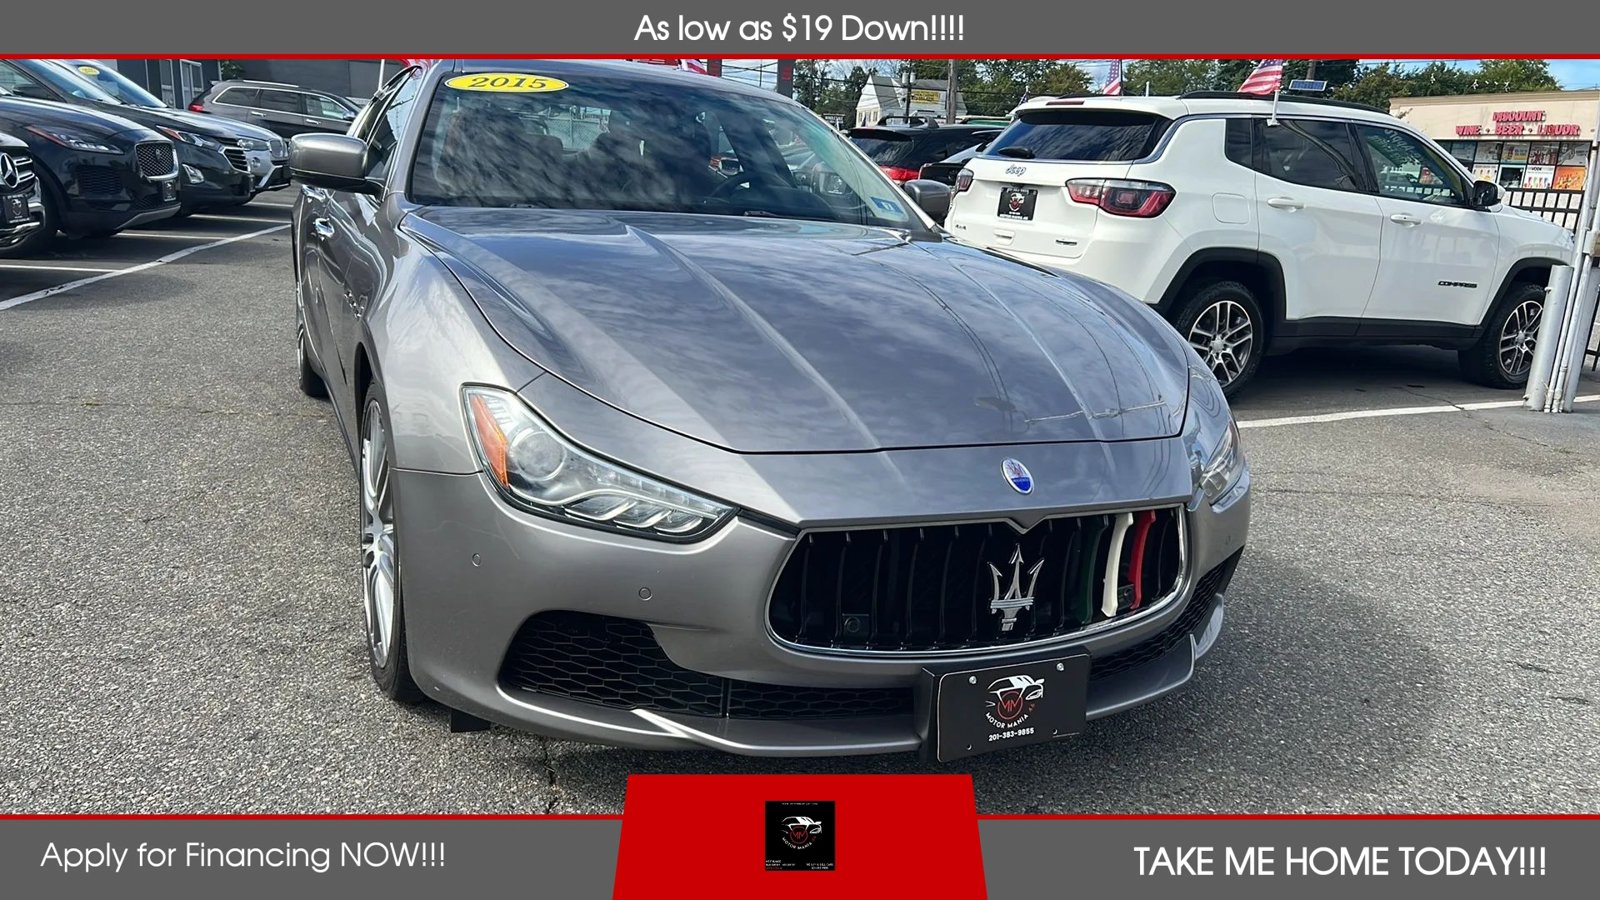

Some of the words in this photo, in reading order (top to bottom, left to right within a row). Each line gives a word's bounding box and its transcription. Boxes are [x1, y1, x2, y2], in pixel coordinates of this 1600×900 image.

[469, 77, 547, 89] 2015
[1492, 110, 1544, 122] DISCOUNT
[1456, 125, 1482, 136] WINE
[1495, 124, 1524, 136] BEER
[1537, 123, 1580, 136] LIQUOR
[985, 712, 1006, 729] MOTOR
[1007, 714, 1029, 729] MANIA
[988, 727, 1035, 742] 201-383-9855
